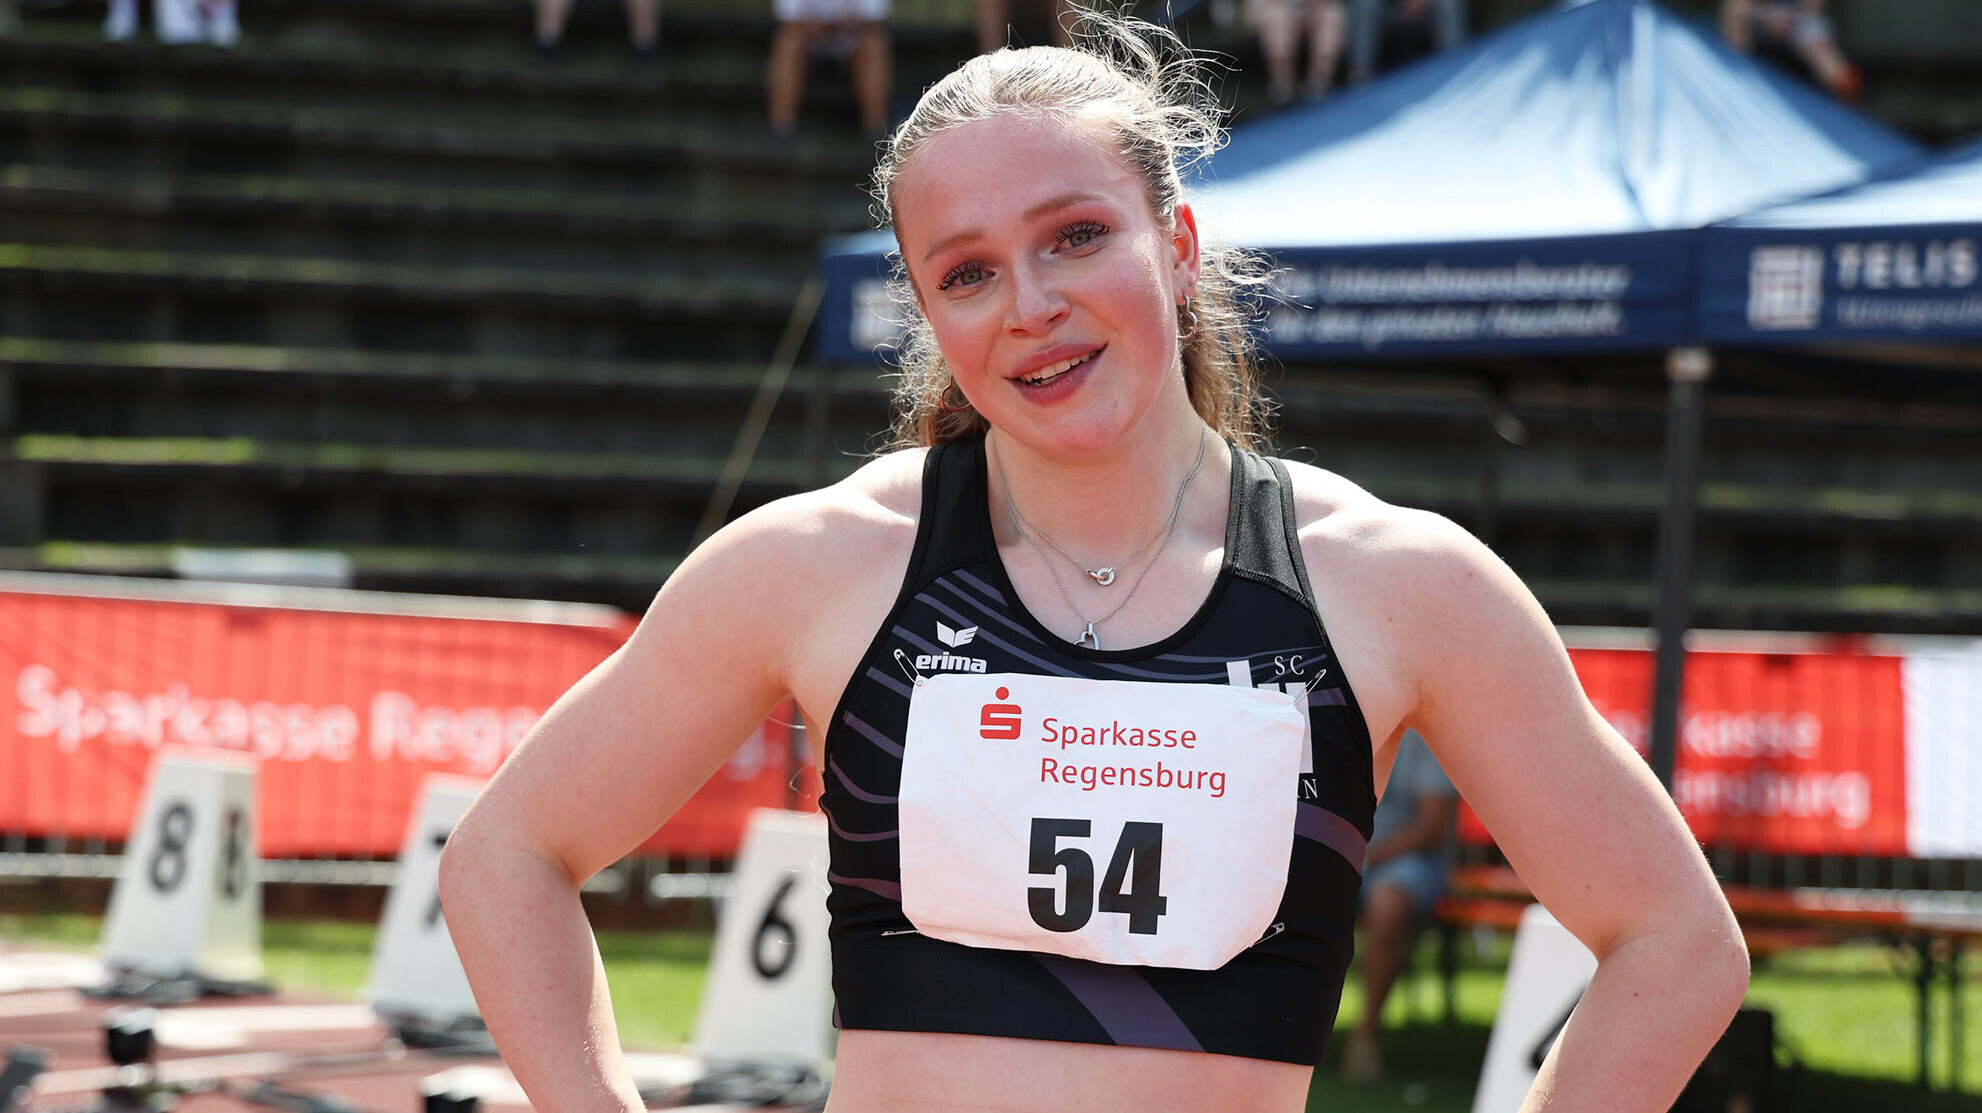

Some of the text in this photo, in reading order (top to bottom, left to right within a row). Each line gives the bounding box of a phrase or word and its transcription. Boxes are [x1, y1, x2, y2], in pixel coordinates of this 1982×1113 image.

[1833, 239, 1976, 289] TELIS
[915, 651, 987, 674] erima
[1274, 655, 1304, 675] SC
[15, 664, 360, 762] Sparkasse
[1041, 718, 1197, 749] Sparkasse
[1040, 757, 1226, 798] Regensburg
[150, 802, 194, 897] 8
[1027, 817, 1167, 936] 54
[751, 868, 799, 979] 6
